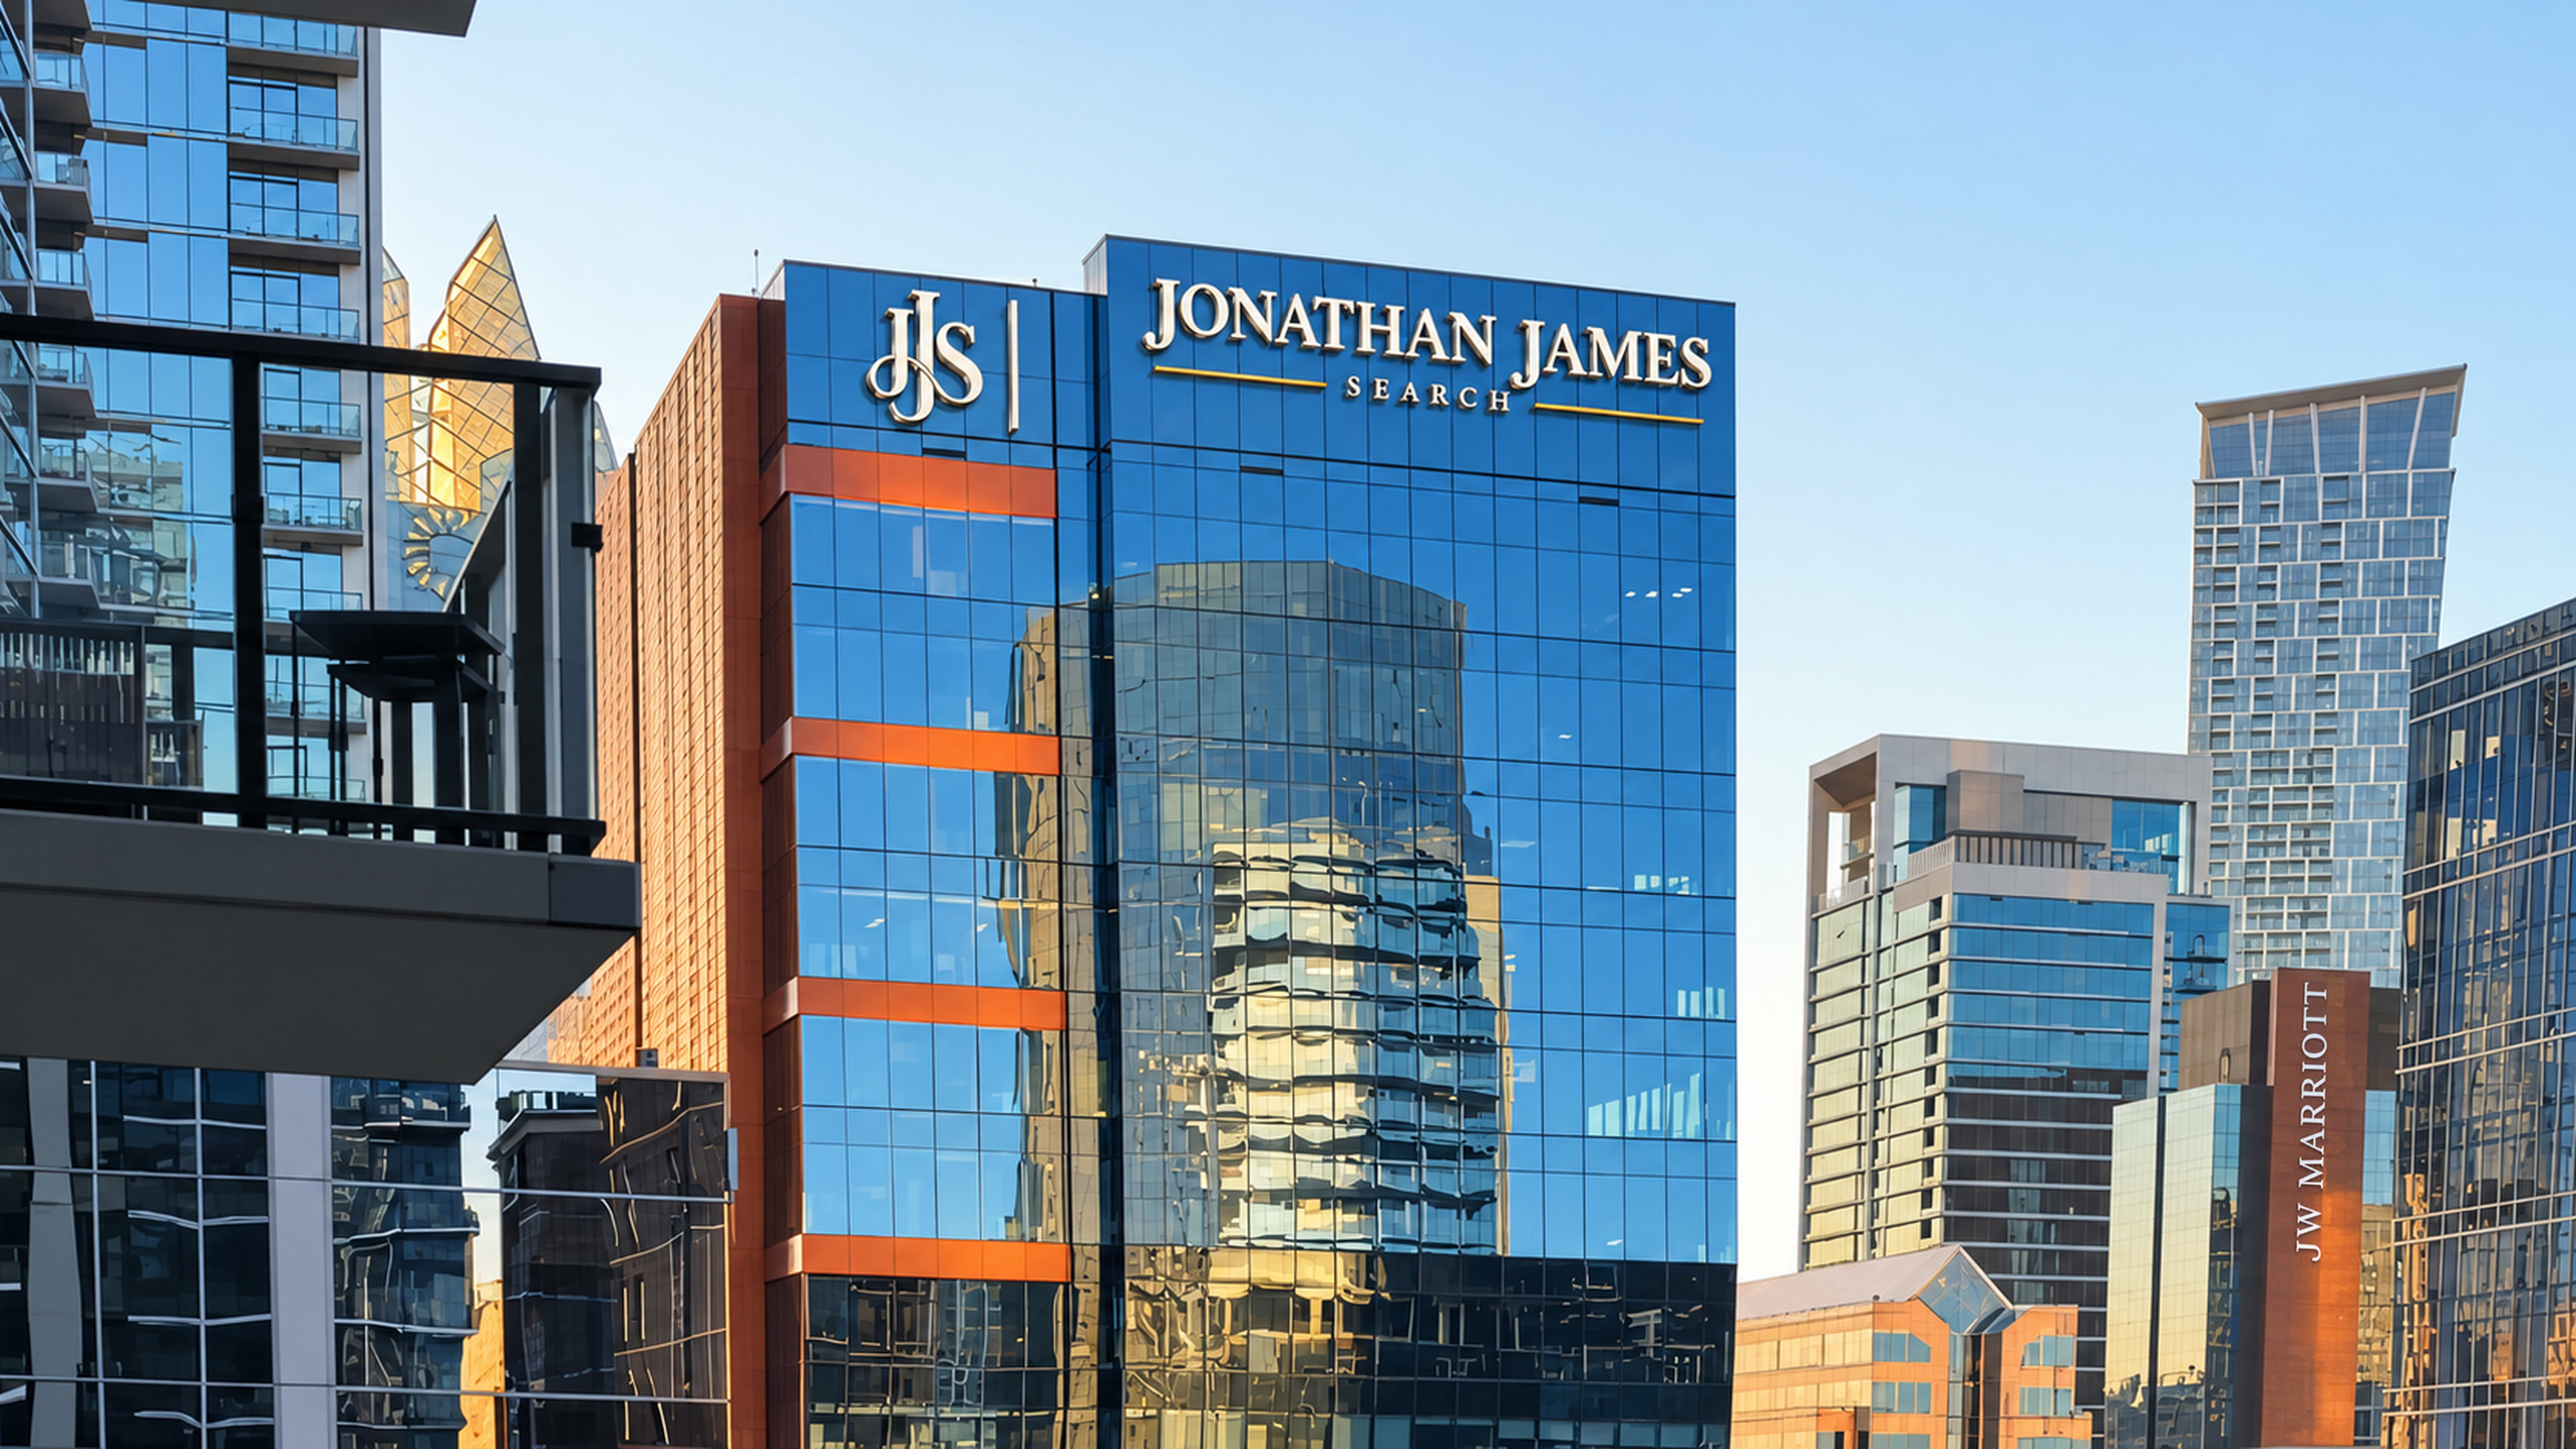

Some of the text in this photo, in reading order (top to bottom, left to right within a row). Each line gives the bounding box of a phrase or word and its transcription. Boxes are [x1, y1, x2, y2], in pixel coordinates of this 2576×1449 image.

[1141, 276, 1713, 390] JONATHAN JAMES
[1346, 374, 1511, 413] SEARCH
[2295, 981, 2328, 1263] JW MARRIOTT
